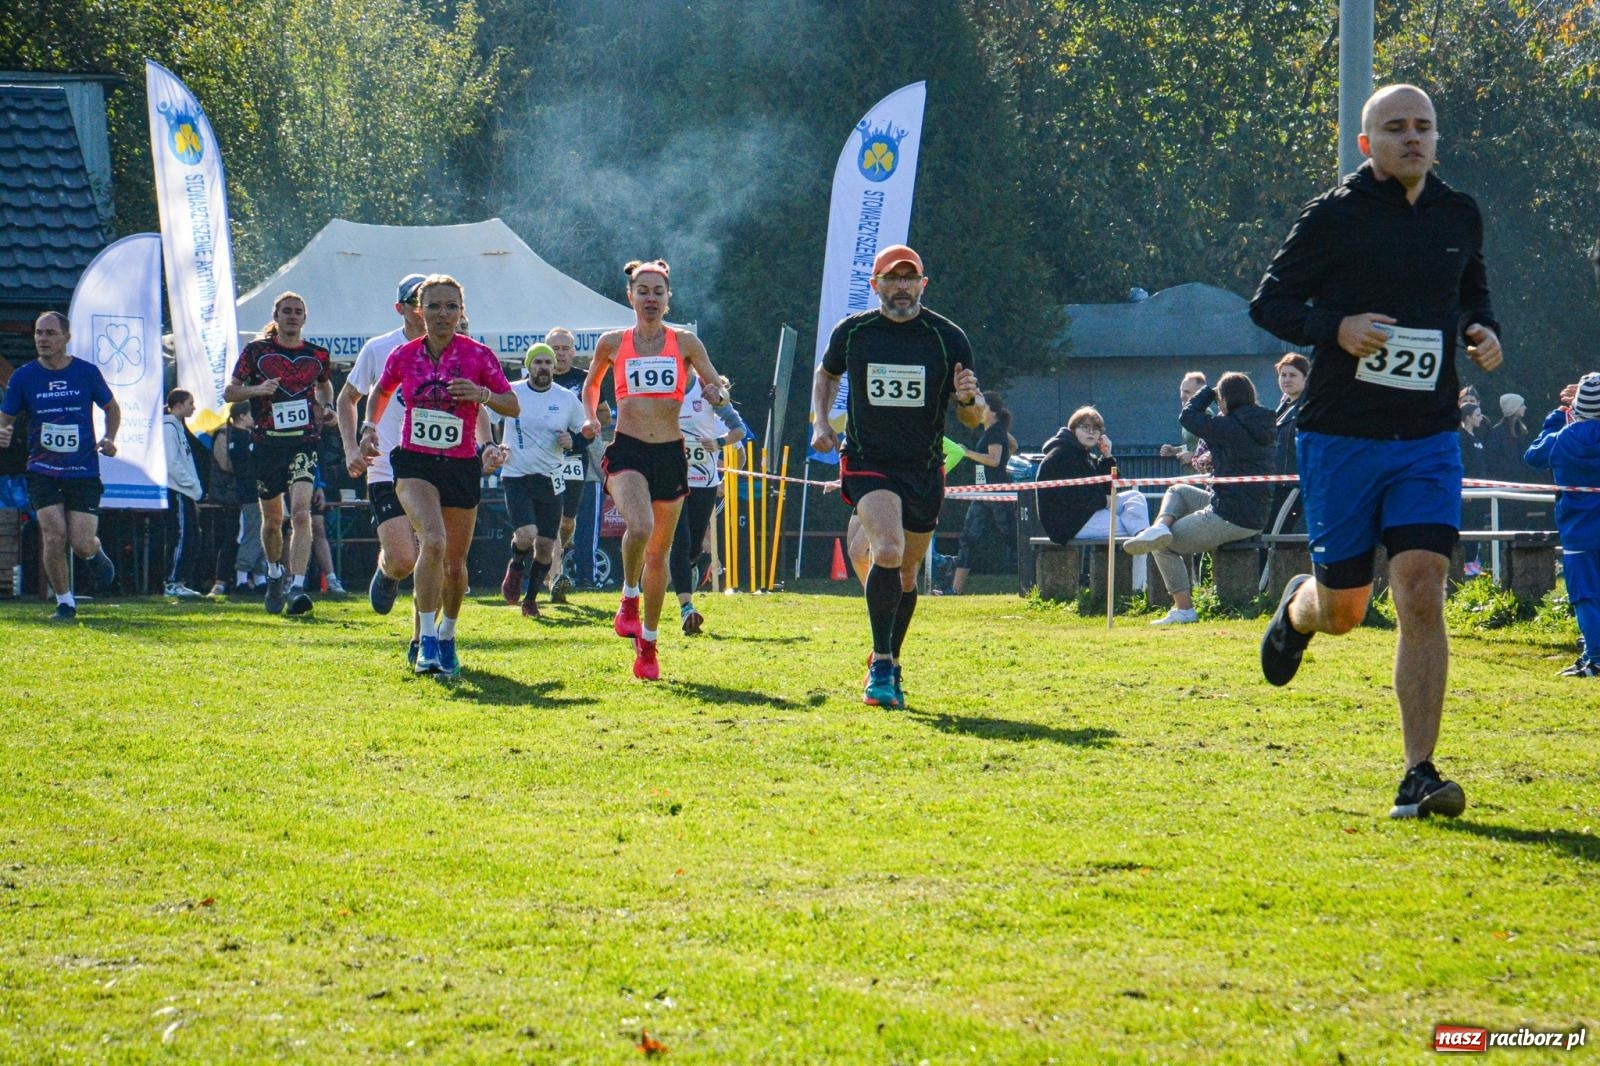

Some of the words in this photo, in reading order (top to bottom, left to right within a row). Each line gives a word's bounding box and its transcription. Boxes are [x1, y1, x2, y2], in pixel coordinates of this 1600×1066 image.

[185, 174, 213, 257] STOWARZYSZENIE
[853, 189, 885, 268] STOWARZYSZENIE
[848, 268, 873, 311] AKTYWNI
[575, 333, 601, 351] JUT
[1365, 347, 1436, 379] 329
[629, 369, 675, 387] 196
[871, 379, 921, 399] 335
[276, 408, 307, 424] 150
[43, 433, 77, 447] 305
[413, 421, 459, 443] 309
[563, 465, 581, 476] 46
